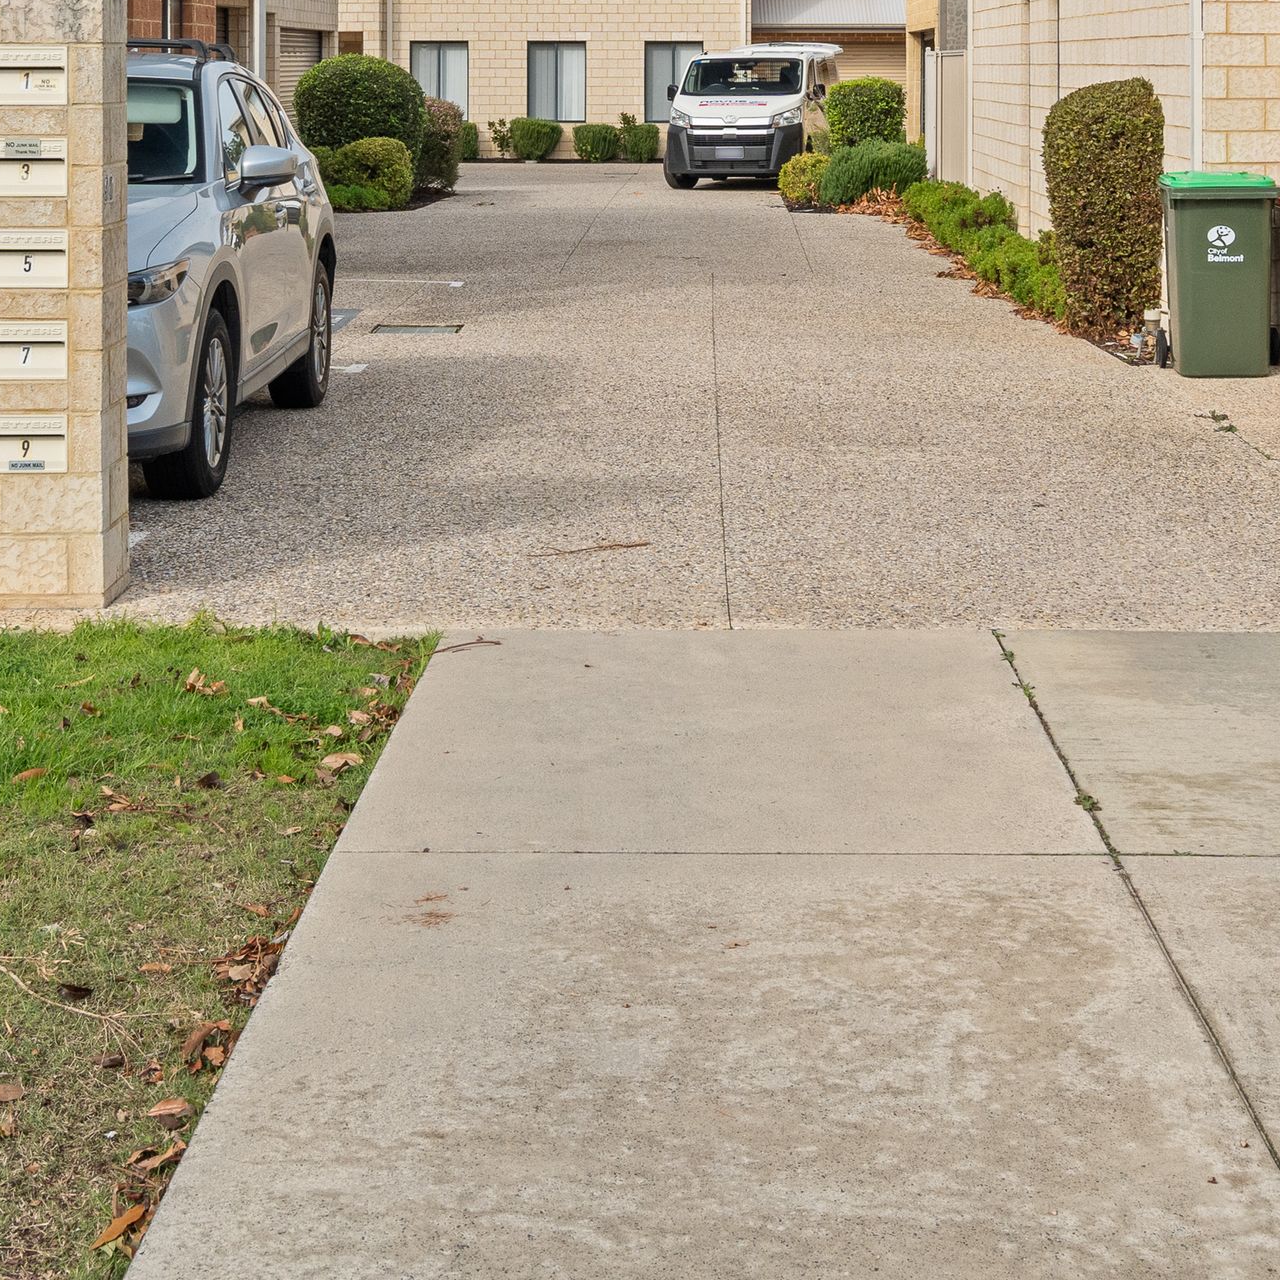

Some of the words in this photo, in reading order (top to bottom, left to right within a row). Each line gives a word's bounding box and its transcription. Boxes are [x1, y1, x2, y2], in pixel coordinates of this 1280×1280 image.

[23, 72, 30, 90] 1
[21, 163, 30, 181] 3
[23, 255, 33, 272] 5
[1207, 254, 1245, 262] Belmont
[22, 346, 31, 365] 7
[21, 440, 30, 458] 9
